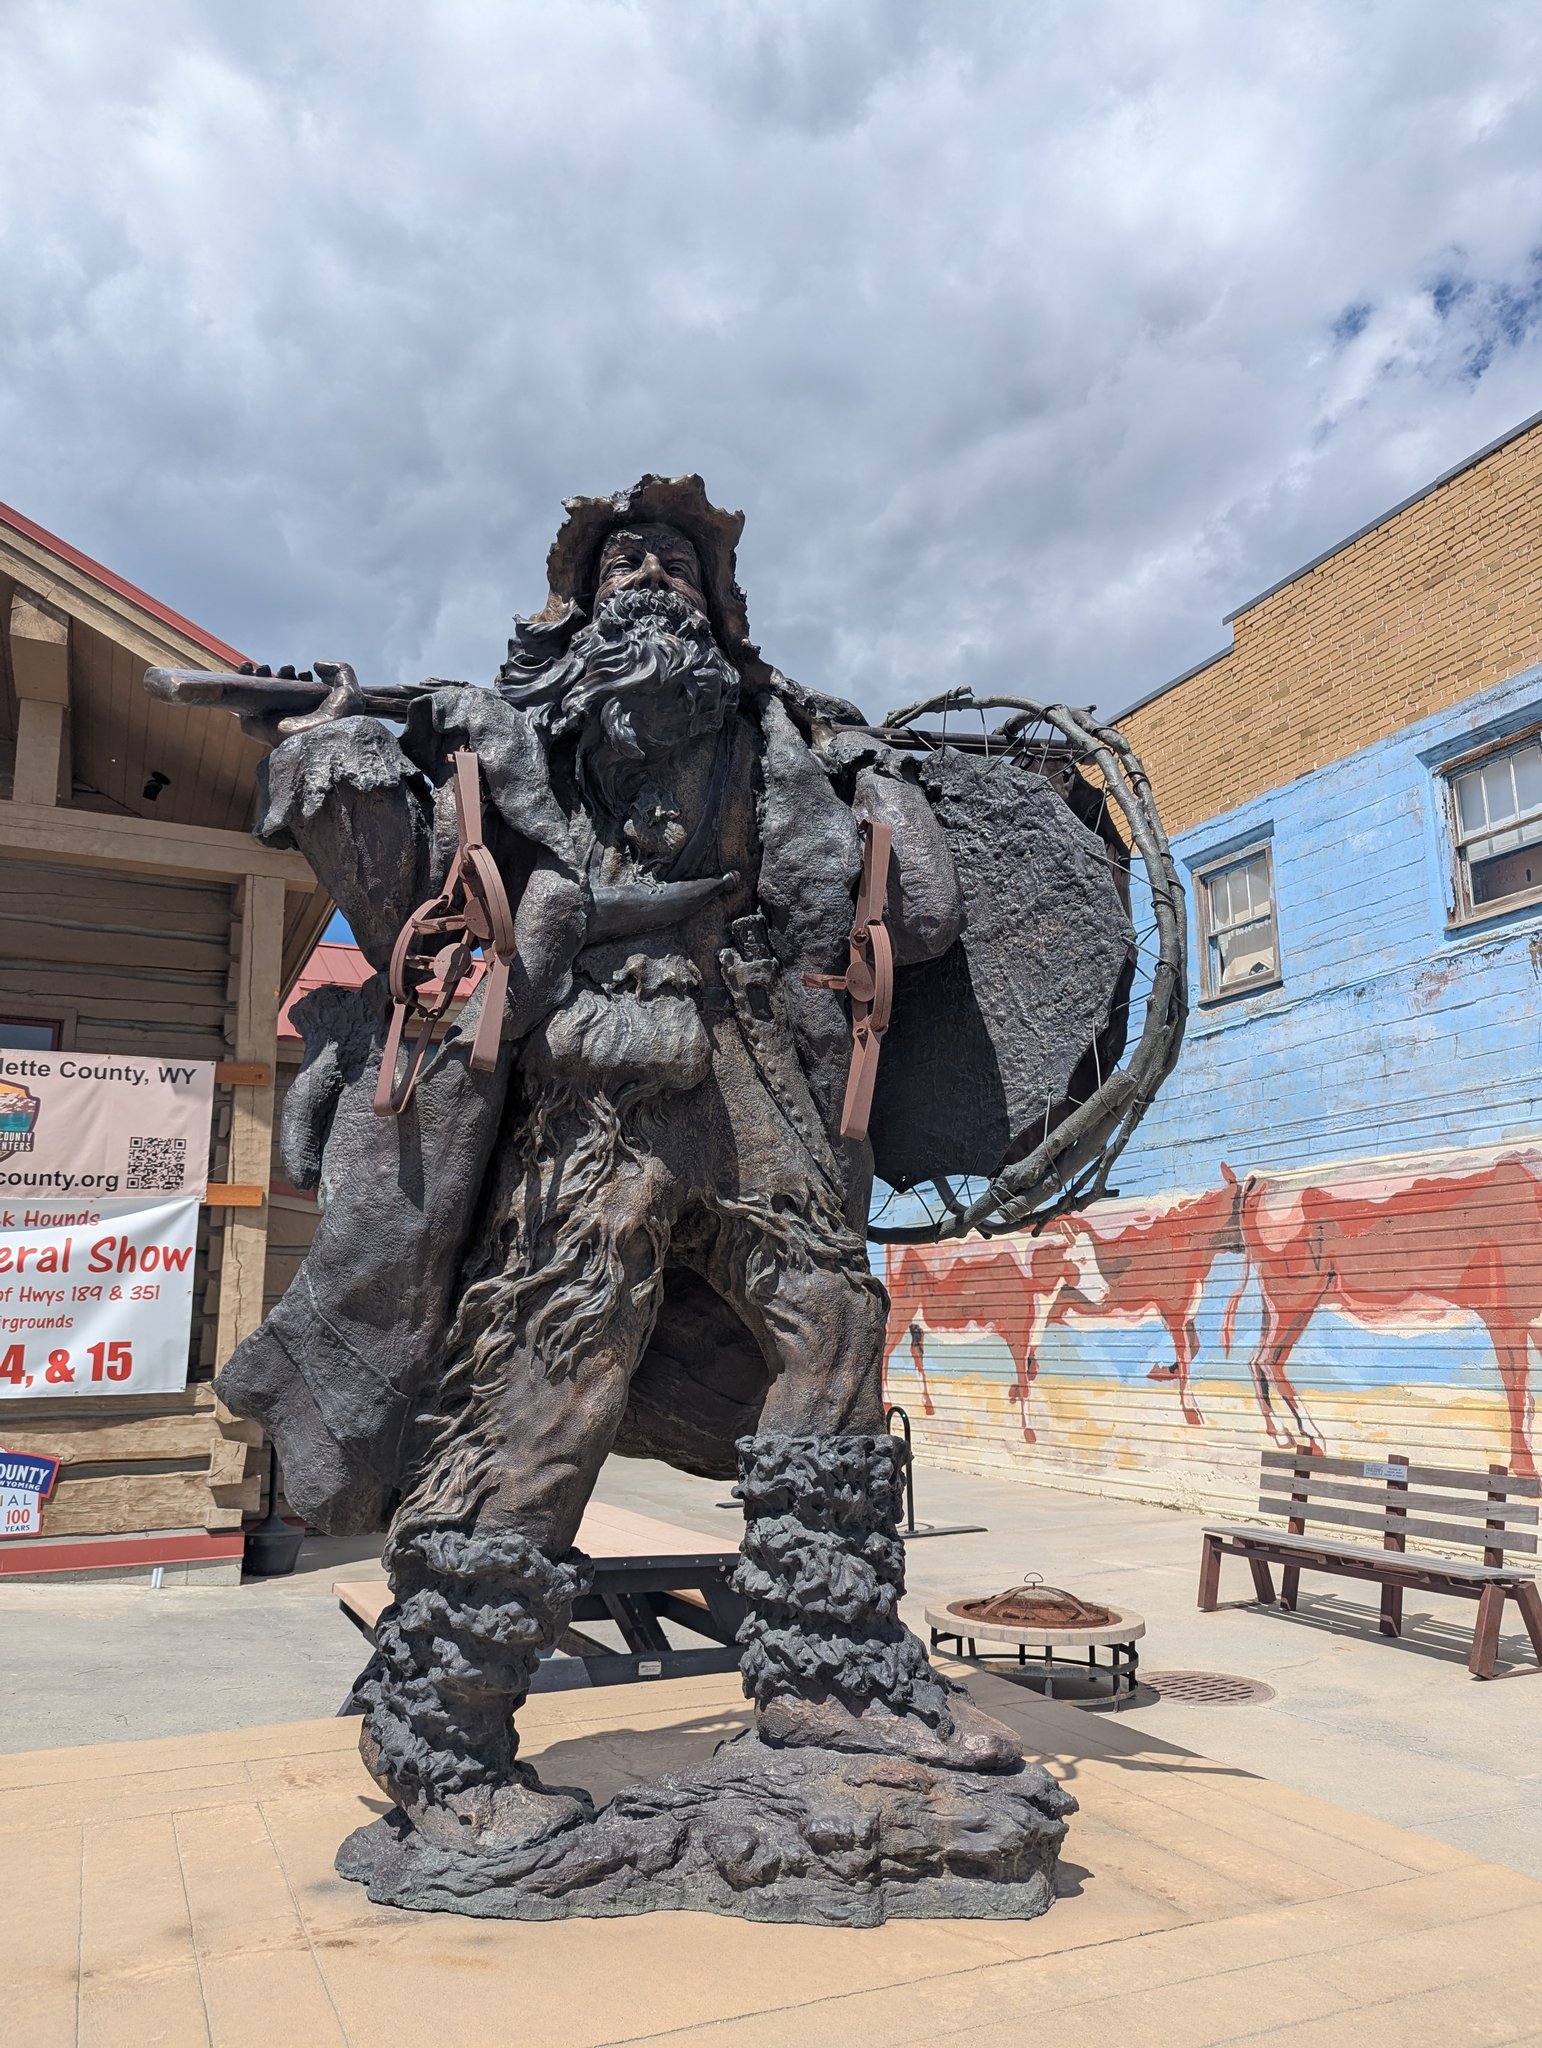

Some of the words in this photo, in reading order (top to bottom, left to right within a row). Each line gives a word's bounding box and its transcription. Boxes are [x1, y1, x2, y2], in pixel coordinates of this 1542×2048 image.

[0, 1057, 51, 1077] lette
[60, 1061, 150, 1086] County,
[158, 1066, 198, 1085] WY
[0, 1132, 33, 1142] COUNTY
[0, 1141, 32, 1152] NTERS
[0, 1171, 119, 1191] county.org
[0, 1211, 15, 1227] k
[24, 1210, 101, 1227] Hounds
[0, 1237, 73, 1274] eral
[87, 1235, 193, 1274] Show
[19, 1286, 65, 1306] Hwys
[71, 1285, 103, 1301] 189
[109, 1285, 124, 1300] &
[130, 1285, 160, 1300] 351
[0, 1344, 34, 1388] 4,
[45, 1348, 75, 1384] &
[87, 1341, 133, 1382] 15
[0, 1463, 50, 1485] OUNTY
[6, 1509, 30, 1525] 100
